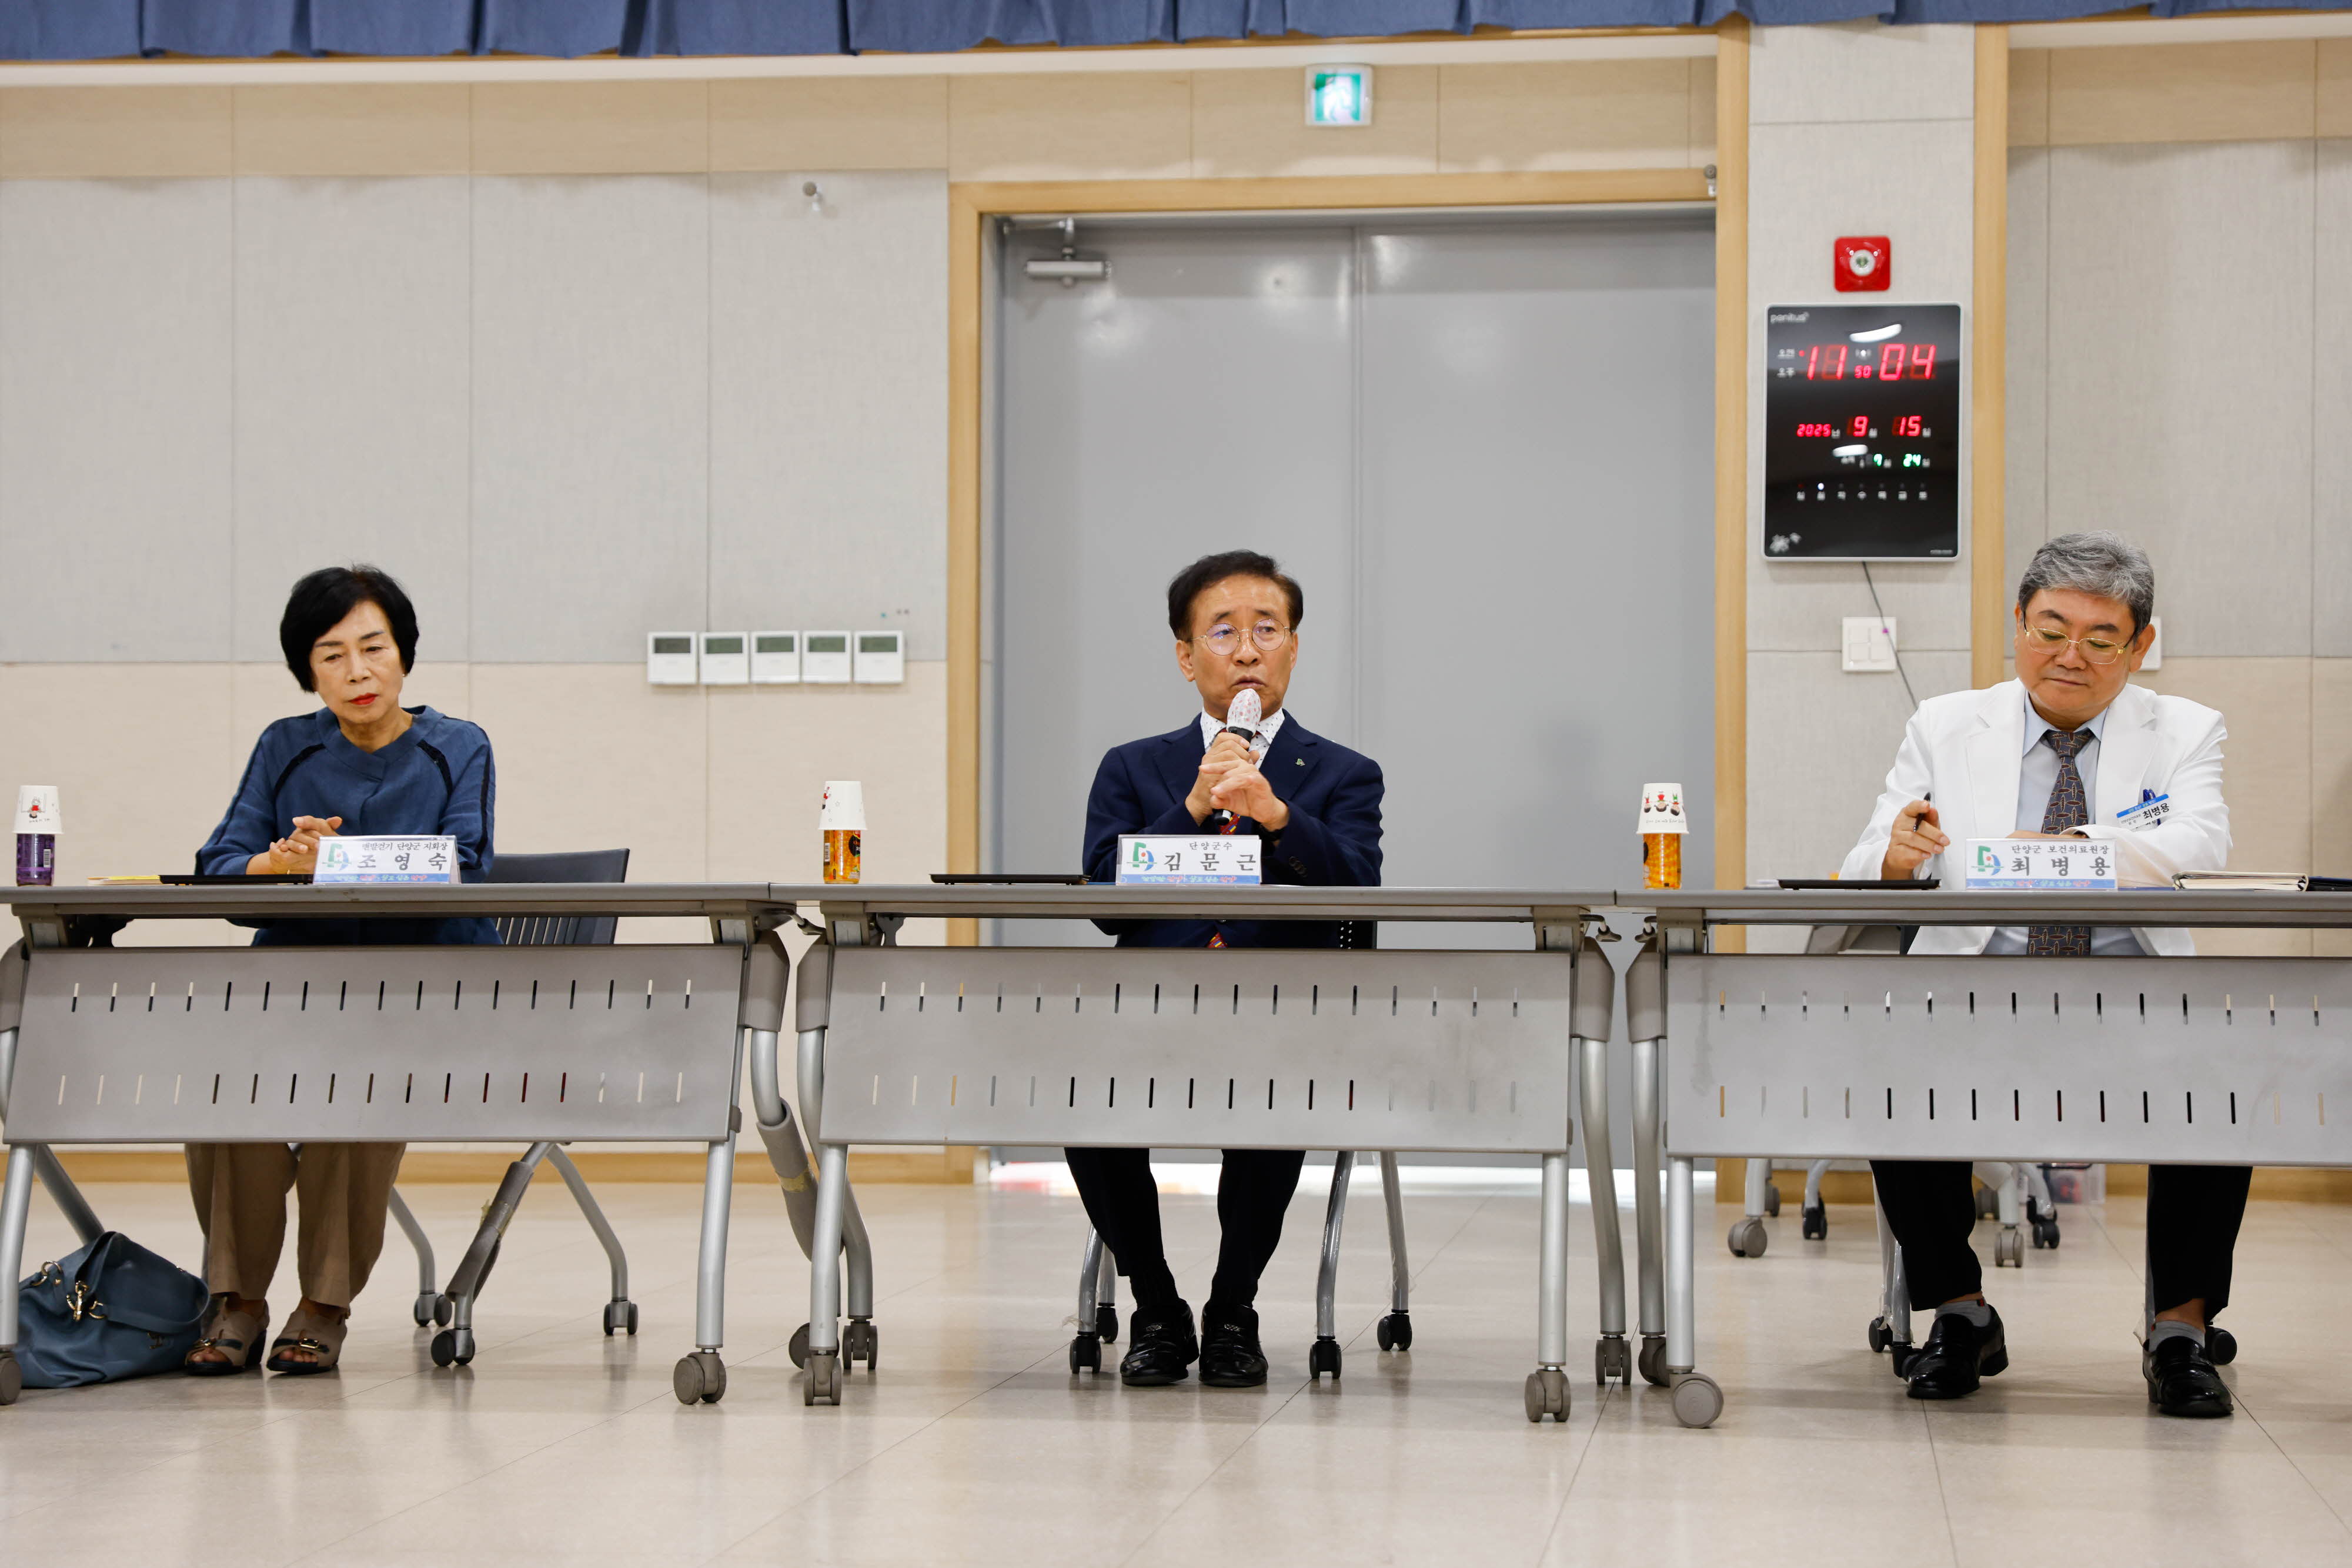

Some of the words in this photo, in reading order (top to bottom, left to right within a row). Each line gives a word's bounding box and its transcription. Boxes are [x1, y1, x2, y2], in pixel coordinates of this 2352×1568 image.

[1879, 343, 1936, 380] 04
[1854, 365, 1872, 379] 50
[1796, 423, 1831, 437] 2025
[1853, 416, 1869, 437] 9
[1899, 415, 1922, 437] 15
[1903, 453, 1921, 467] 24
[2142, 803, 2170, 819] 최병용
[397, 842, 421, 851] 단양군
[423, 842, 449, 851] 지회장
[1189, 841, 1232, 851] 단양군수
[2011, 844, 2042, 854] 단양군
[2047, 844, 2110, 854] 보건의료원장
[1164, 852, 1181, 871] 김
[1200, 853, 1220, 871] 문
[1236, 854, 1257, 871] 근
[2011, 856, 2030, 876] 최
[2051, 856, 2069, 877] 병
[2089, 856, 2111, 877] 용
